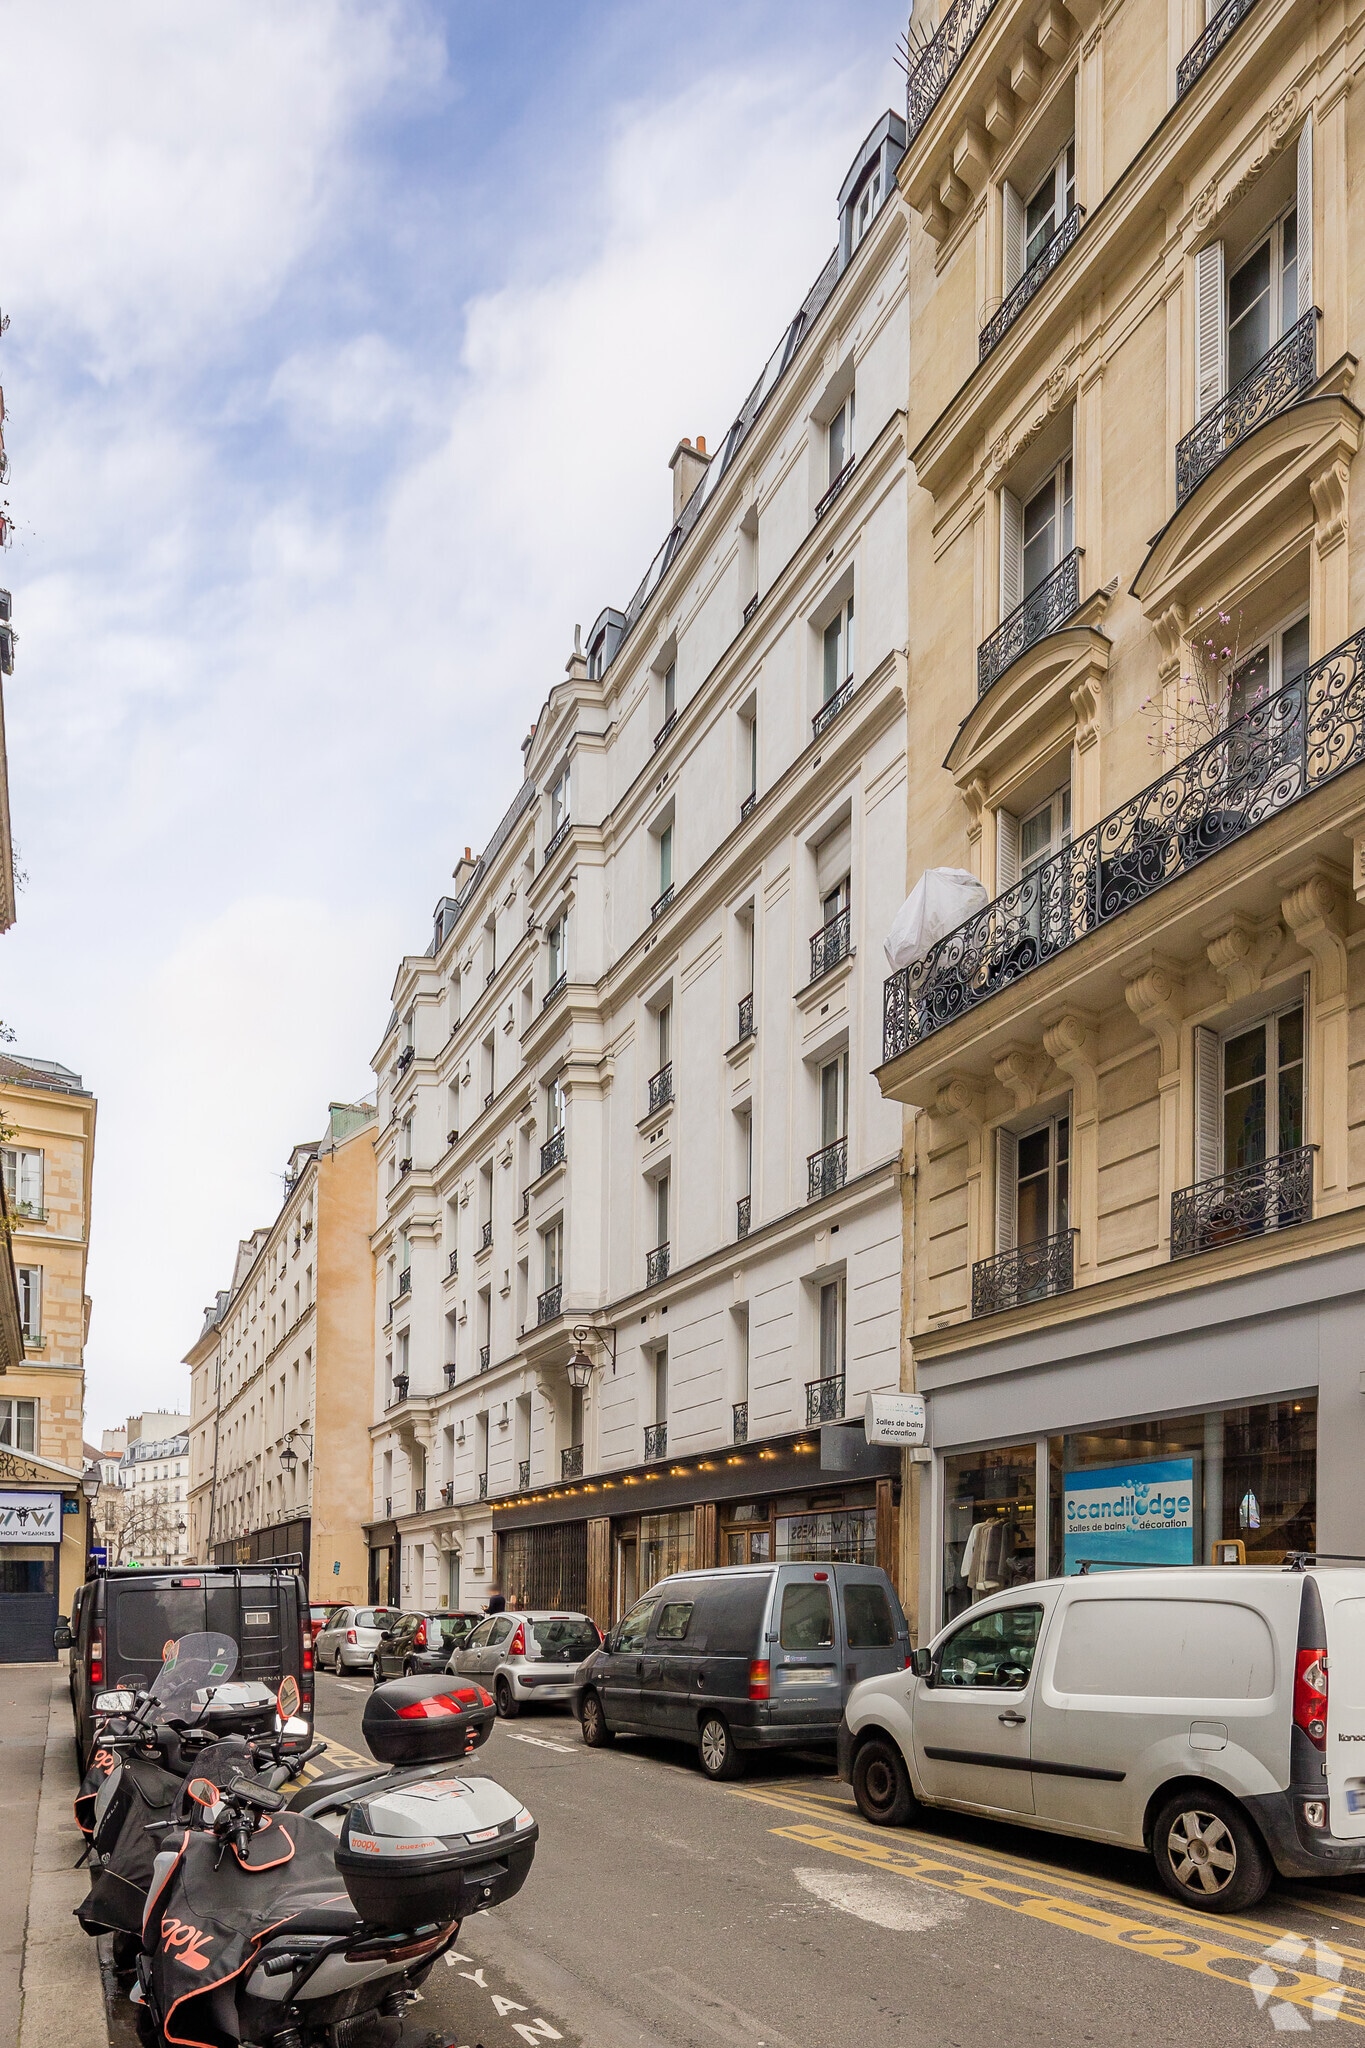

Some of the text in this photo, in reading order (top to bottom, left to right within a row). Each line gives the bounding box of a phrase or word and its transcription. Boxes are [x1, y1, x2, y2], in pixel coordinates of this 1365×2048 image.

[876, 1418, 895, 1426] Salles
[906, 1421, 924, 1429] bains
[881, 1428, 917, 1437] décoration
[1067, 1493, 1191, 1520] Scandilodge
[1069, 1519, 1187, 1533] Salles de bains décoration
[1338, 1733, 1365, 1742] Kango
[351, 1838, 436, 1853] troopy Louez-moi
